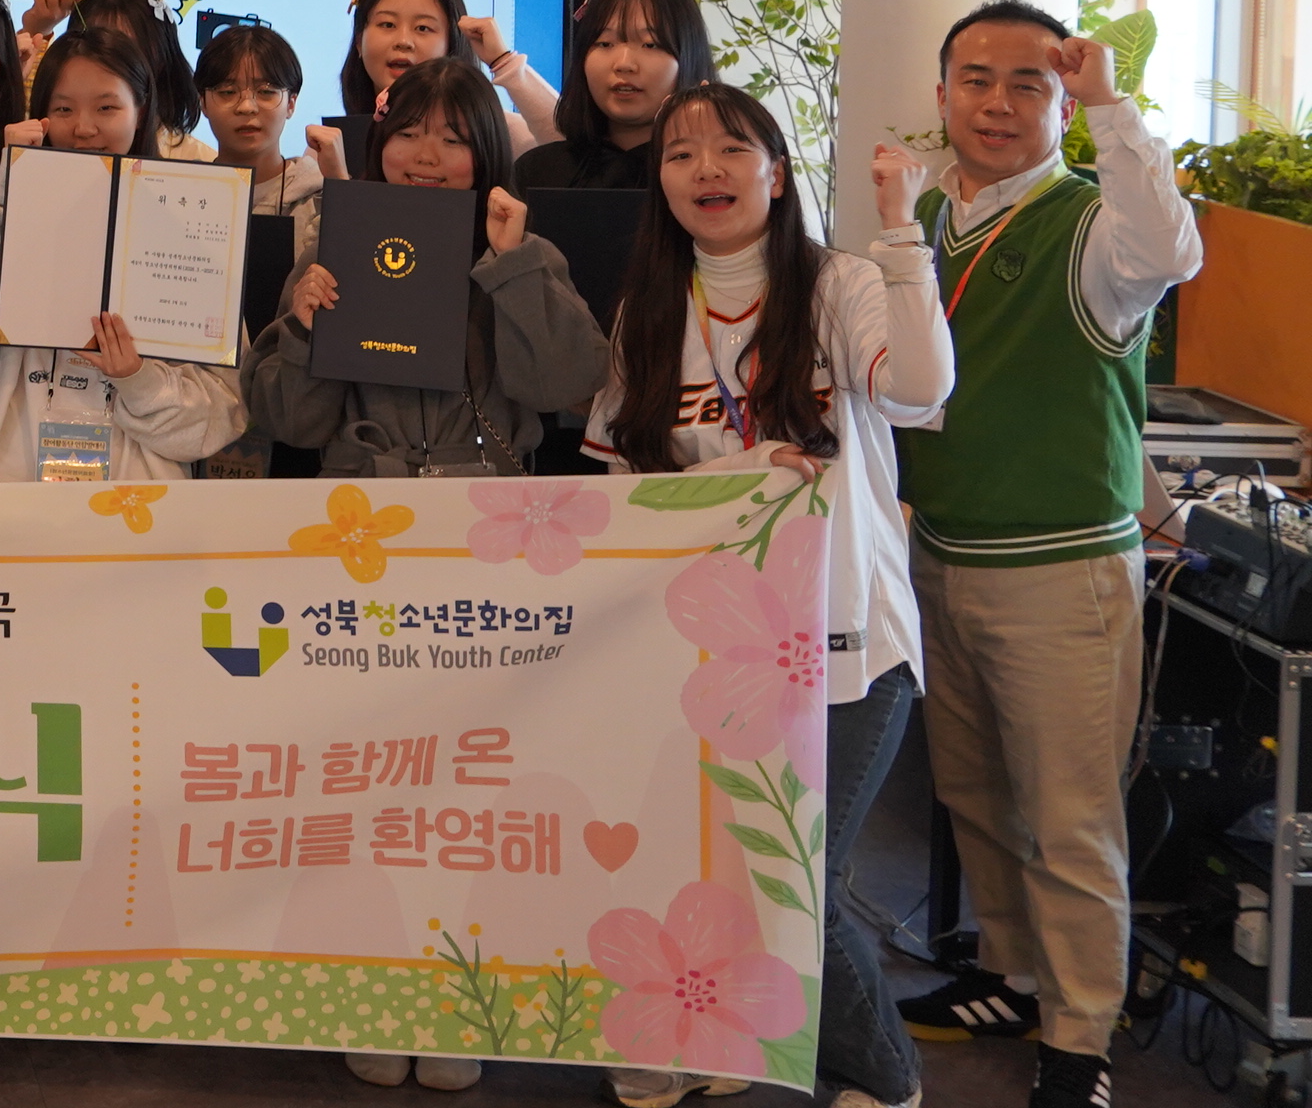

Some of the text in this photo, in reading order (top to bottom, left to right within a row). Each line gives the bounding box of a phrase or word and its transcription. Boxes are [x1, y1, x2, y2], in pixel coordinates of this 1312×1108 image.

[301, 599, 574, 638] 성북청소년문화의집
[302, 642, 565, 673] Seong Buk Youth Center
[180, 727, 514, 803] 봄과 함께 온
[176, 806, 561, 876] 너희를 환영해
